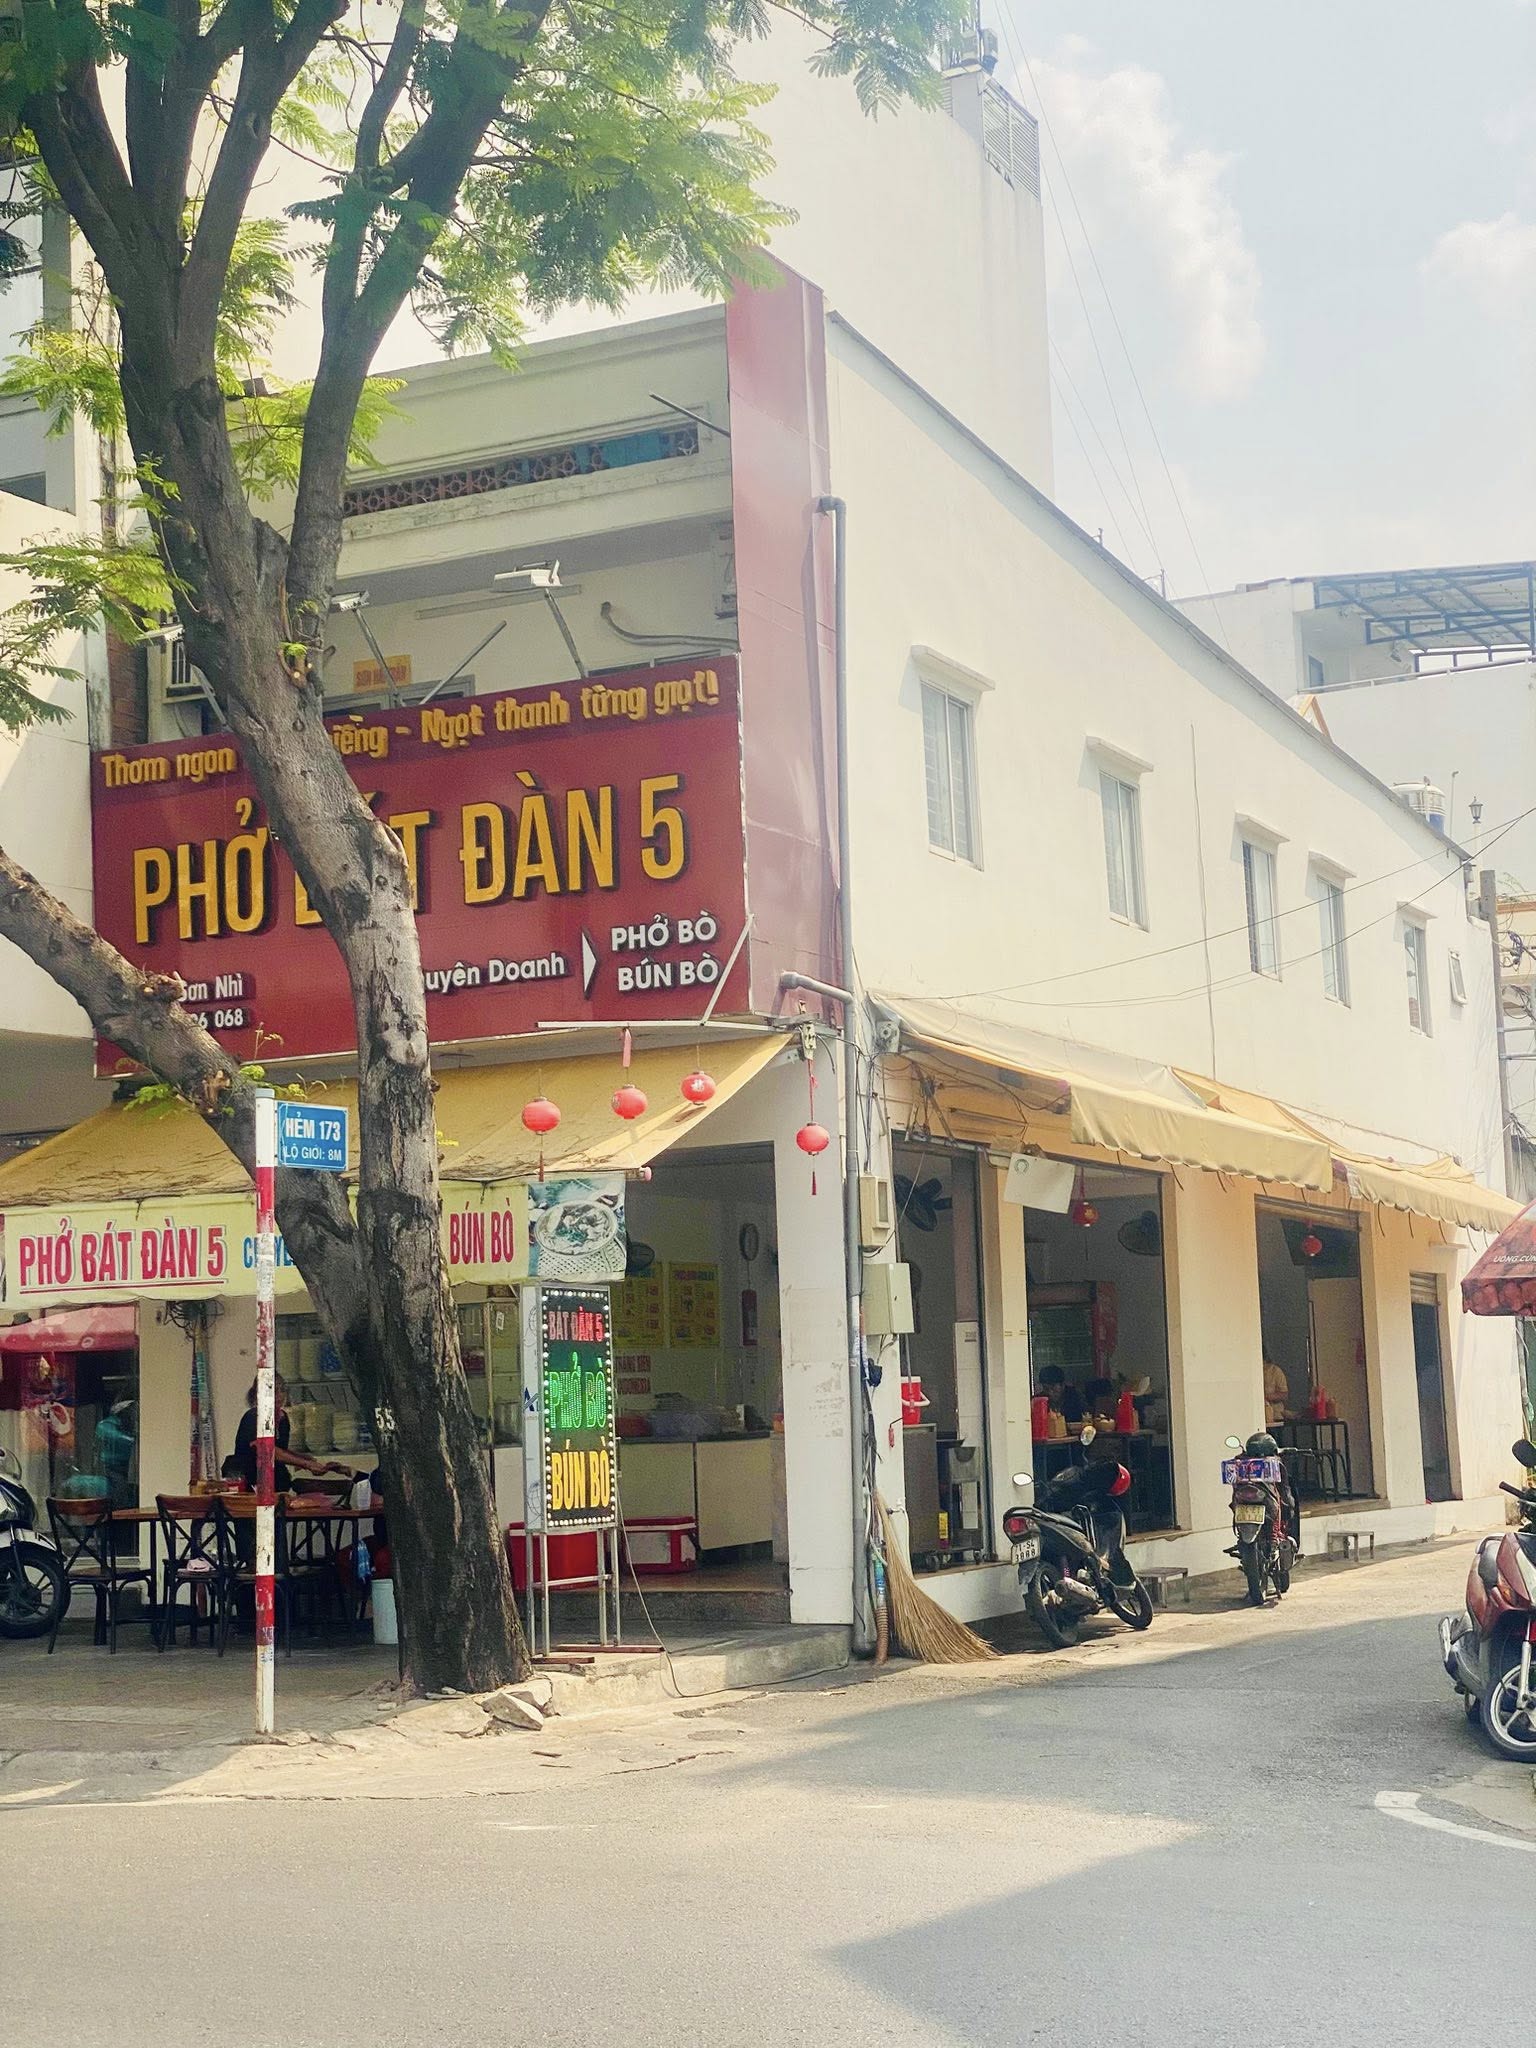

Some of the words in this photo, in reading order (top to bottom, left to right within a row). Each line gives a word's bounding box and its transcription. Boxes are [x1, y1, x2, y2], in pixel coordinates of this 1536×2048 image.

[421, 704, 484, 749] Ngọt
[495, 690, 570, 732] thanh
[581, 684, 647, 720] từng
[654, 669, 719, 715] giọt!
[101, 752, 169, 788] Thơm
[176, 747, 236, 783] ngon
[459, 771, 614, 905] ĐÀN
[640, 775, 686, 879] 5
[133, 797, 270, 944] PHỞ
[611, 914, 669, 951] PHỞ
[678, 910, 717, 944] BÒ
[215, 973, 243, 998] Nhì
[425, 961, 480, 993] uyên
[488, 952, 565, 983] Doanh
[618, 957, 672, 992] BÚN
[680, 952, 719, 985] BÒ
[214, 1008, 244, 1028] 068
[285, 1111, 315, 1139] HẺM
[319, 1120, 341, 1142] 173
[328, 1149, 342, 1161] 8M
[19, 1217, 73, 1287] PHỞ
[81, 1221, 133, 1283] BÁT
[140, 1217, 199, 1281] ĐÀN
[207, 1226, 226, 1278] 5
[450, 1201, 485, 1265] BÚN
[491, 1198, 514, 1264] BÒ
[548, 1305, 569, 1341] BÁT
[595, 1313, 604, 1342] 5
[549, 1351, 582, 1430] PHỞ
[585, 1357, 608, 1430] BÒ
[552, 1438, 586, 1511] BÚN
[589, 1436, 611, 1509] BÒ
